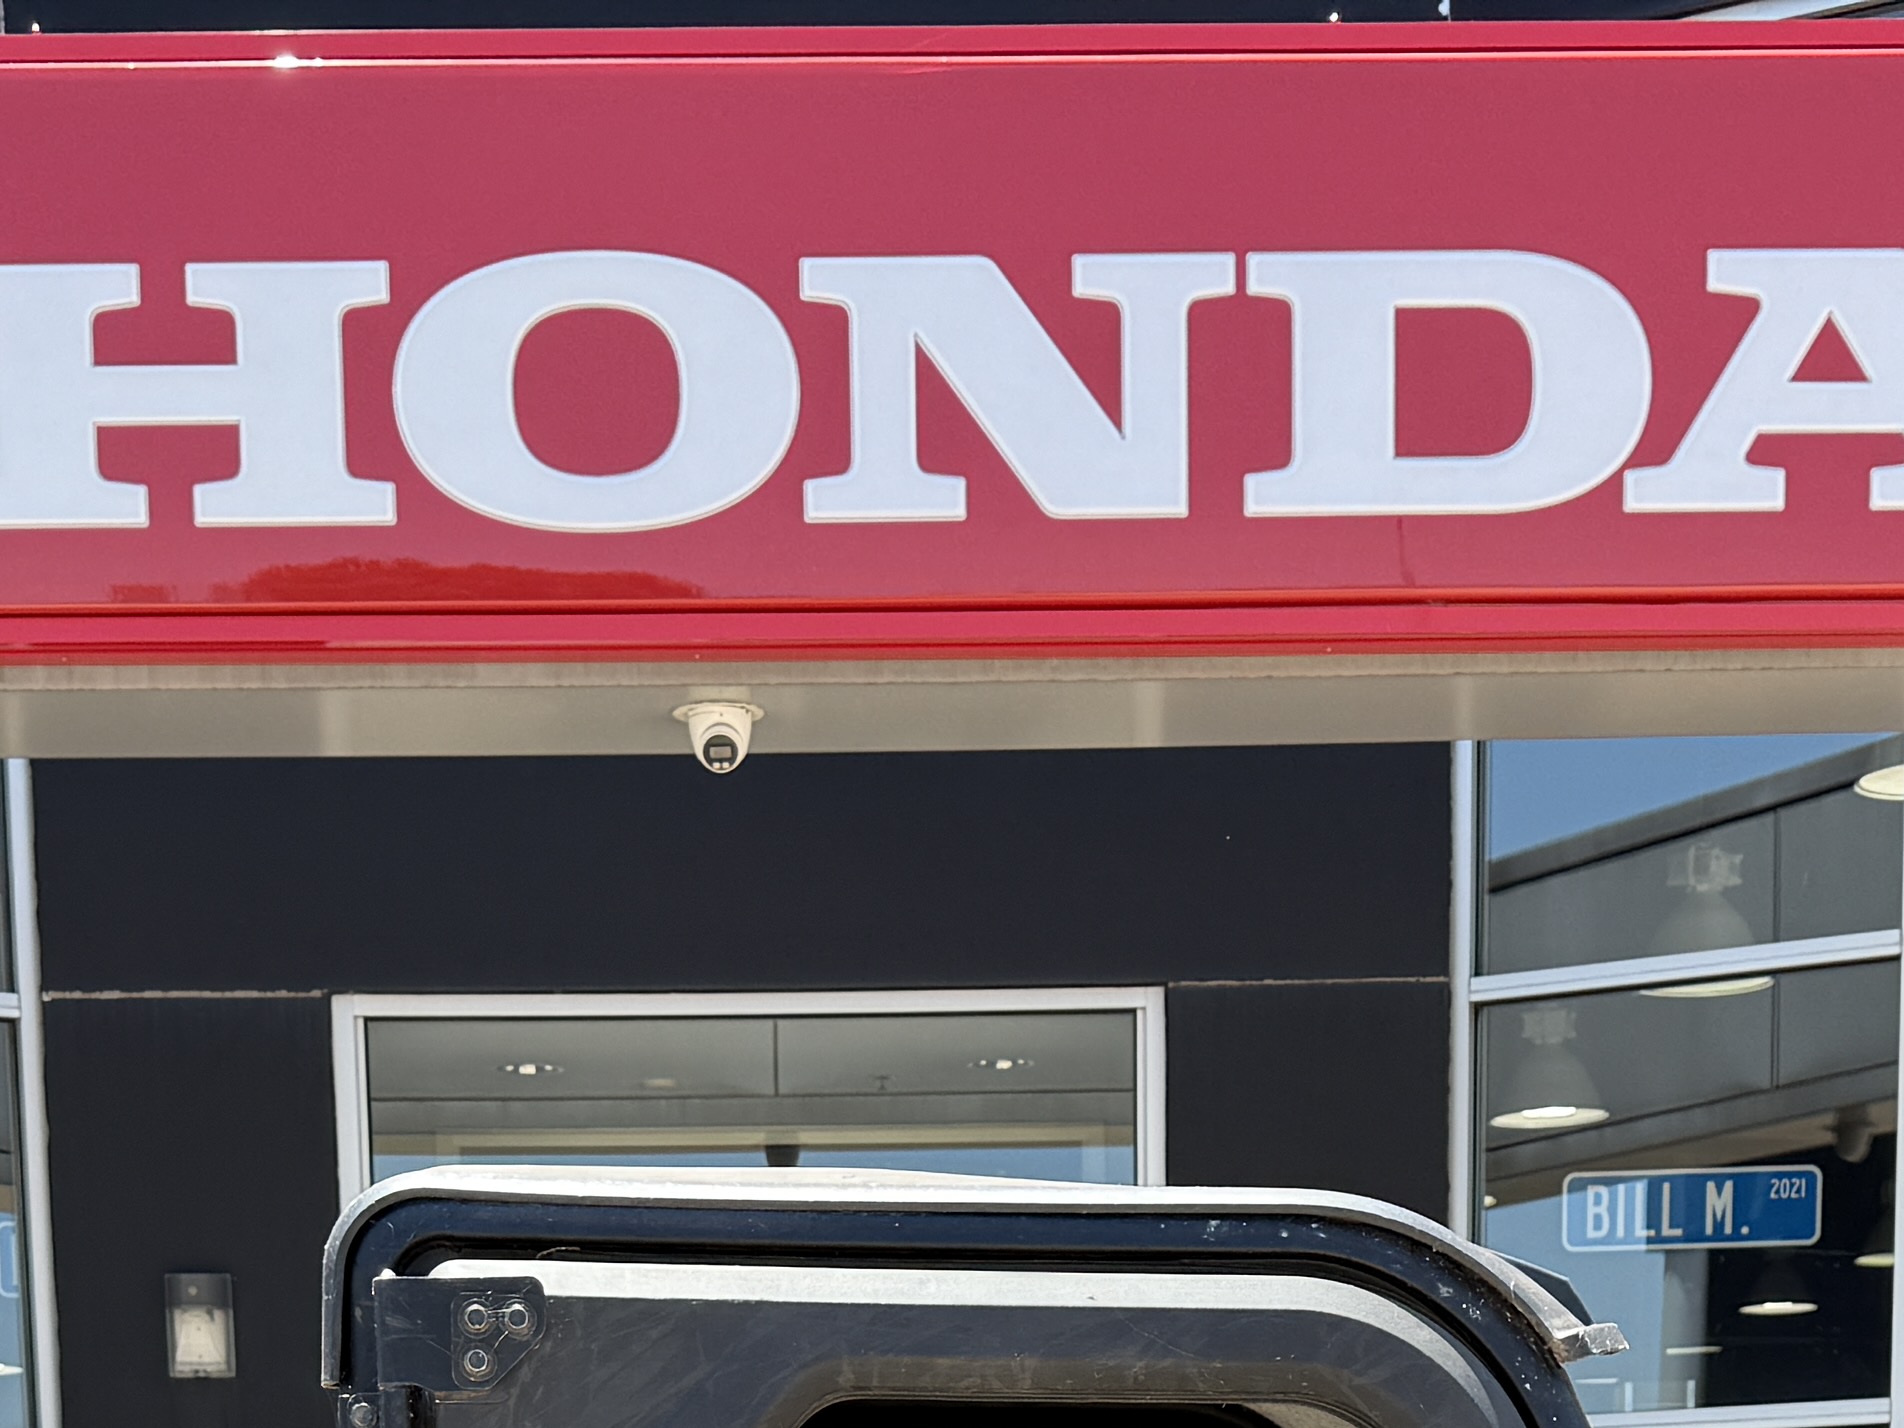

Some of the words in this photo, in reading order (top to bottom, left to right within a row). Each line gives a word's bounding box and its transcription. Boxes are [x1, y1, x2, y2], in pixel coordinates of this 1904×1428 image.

[1585, 1179, 1683, 1240] BILL
[1704, 1178, 1751, 1238] M.
[1769, 1176, 1807, 1200] 2021
